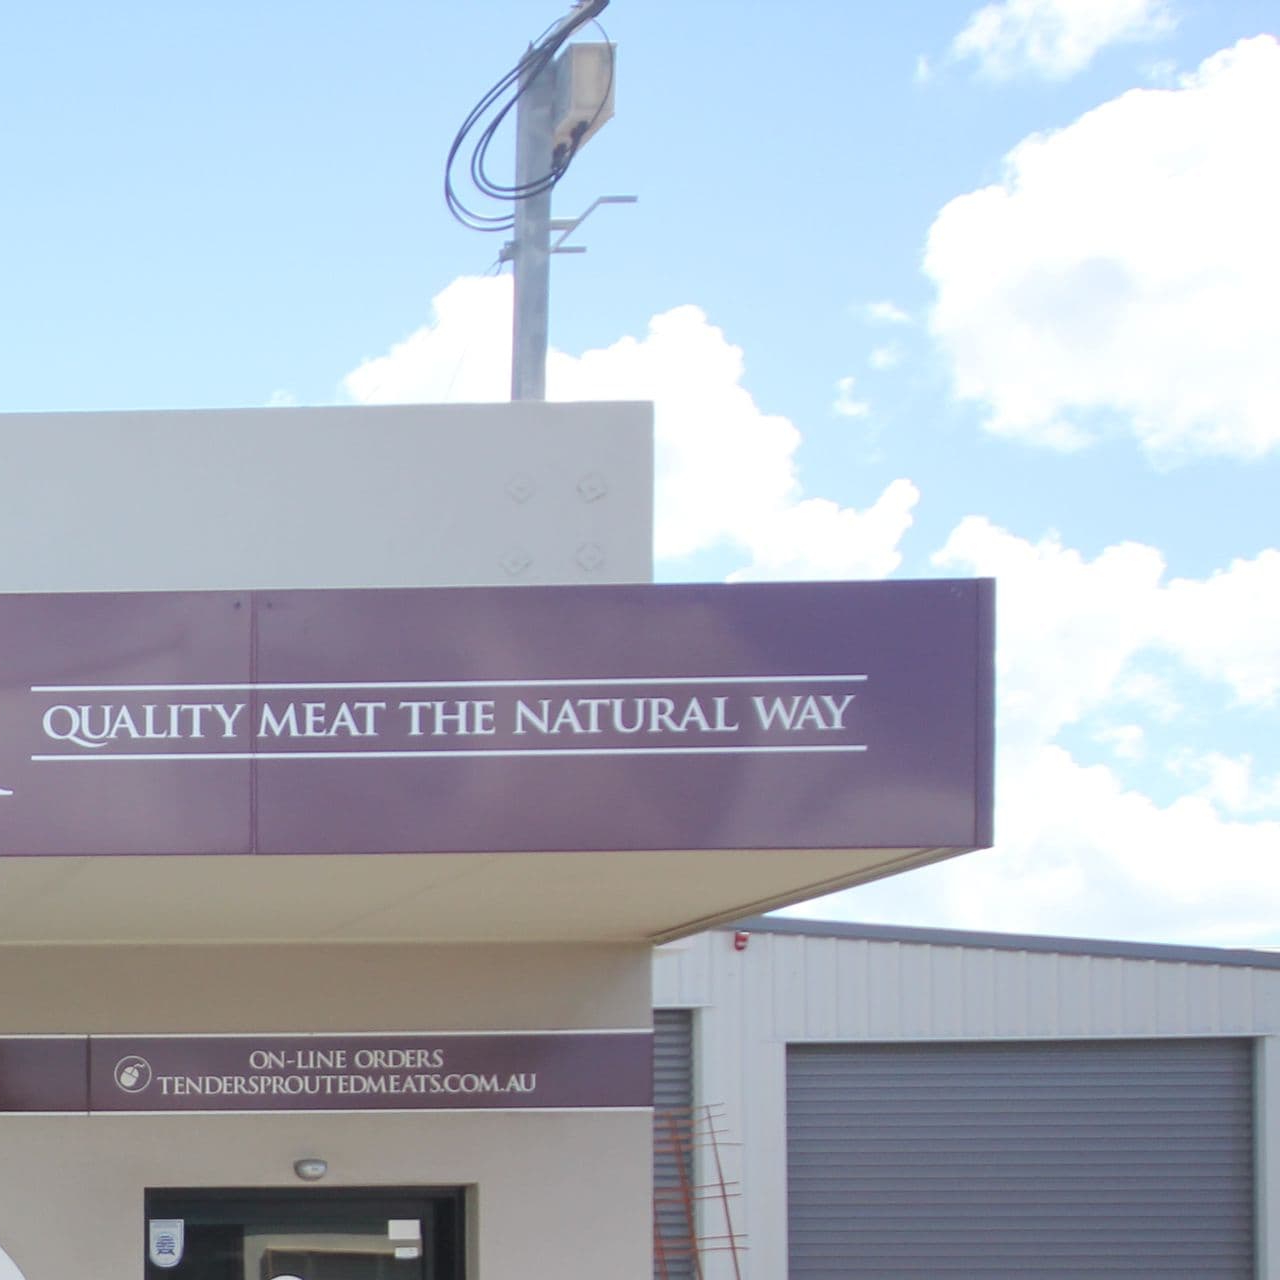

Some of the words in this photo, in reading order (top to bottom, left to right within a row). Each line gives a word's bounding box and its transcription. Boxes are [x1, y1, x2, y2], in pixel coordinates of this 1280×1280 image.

[42, 702, 246, 748] QUALITY
[257, 701, 386, 737] MEAT
[398, 699, 496, 736] THE
[512, 696, 739, 735] NATURAL
[752, 694, 857, 730] WAY
[248, 1050, 347, 1070] ON-LINE
[354, 1048, 445, 1069] ORDERS
[156, 1072, 538, 1096] TENDERSPROUTEDMEATS.COM.AU
